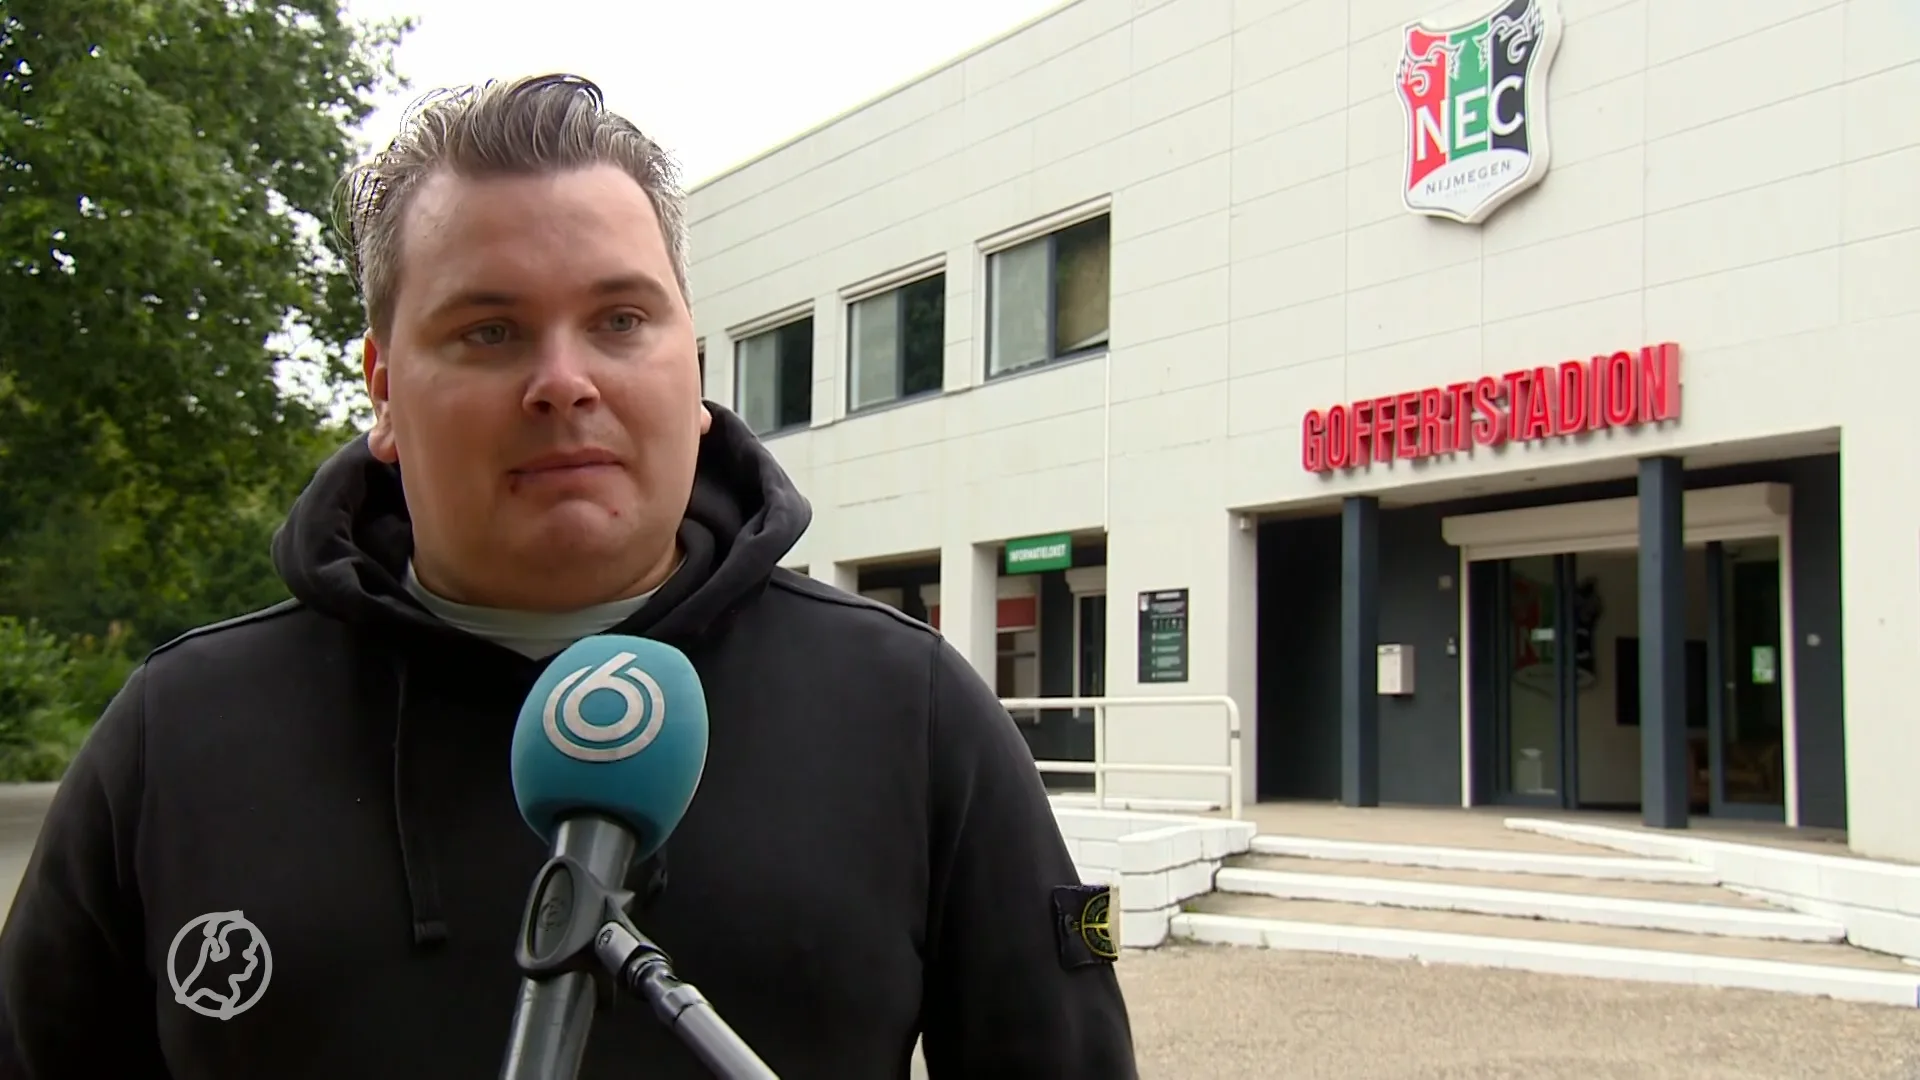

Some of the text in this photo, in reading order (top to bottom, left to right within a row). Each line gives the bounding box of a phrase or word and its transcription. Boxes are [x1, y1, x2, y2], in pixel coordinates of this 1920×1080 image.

[1416, 75, 1524, 161] NEC
[1426, 160, 1511, 195] NIJMEGEN
[1302, 342, 1680, 473] GOFFERTSTADION
[561, 651, 646, 743] 6
